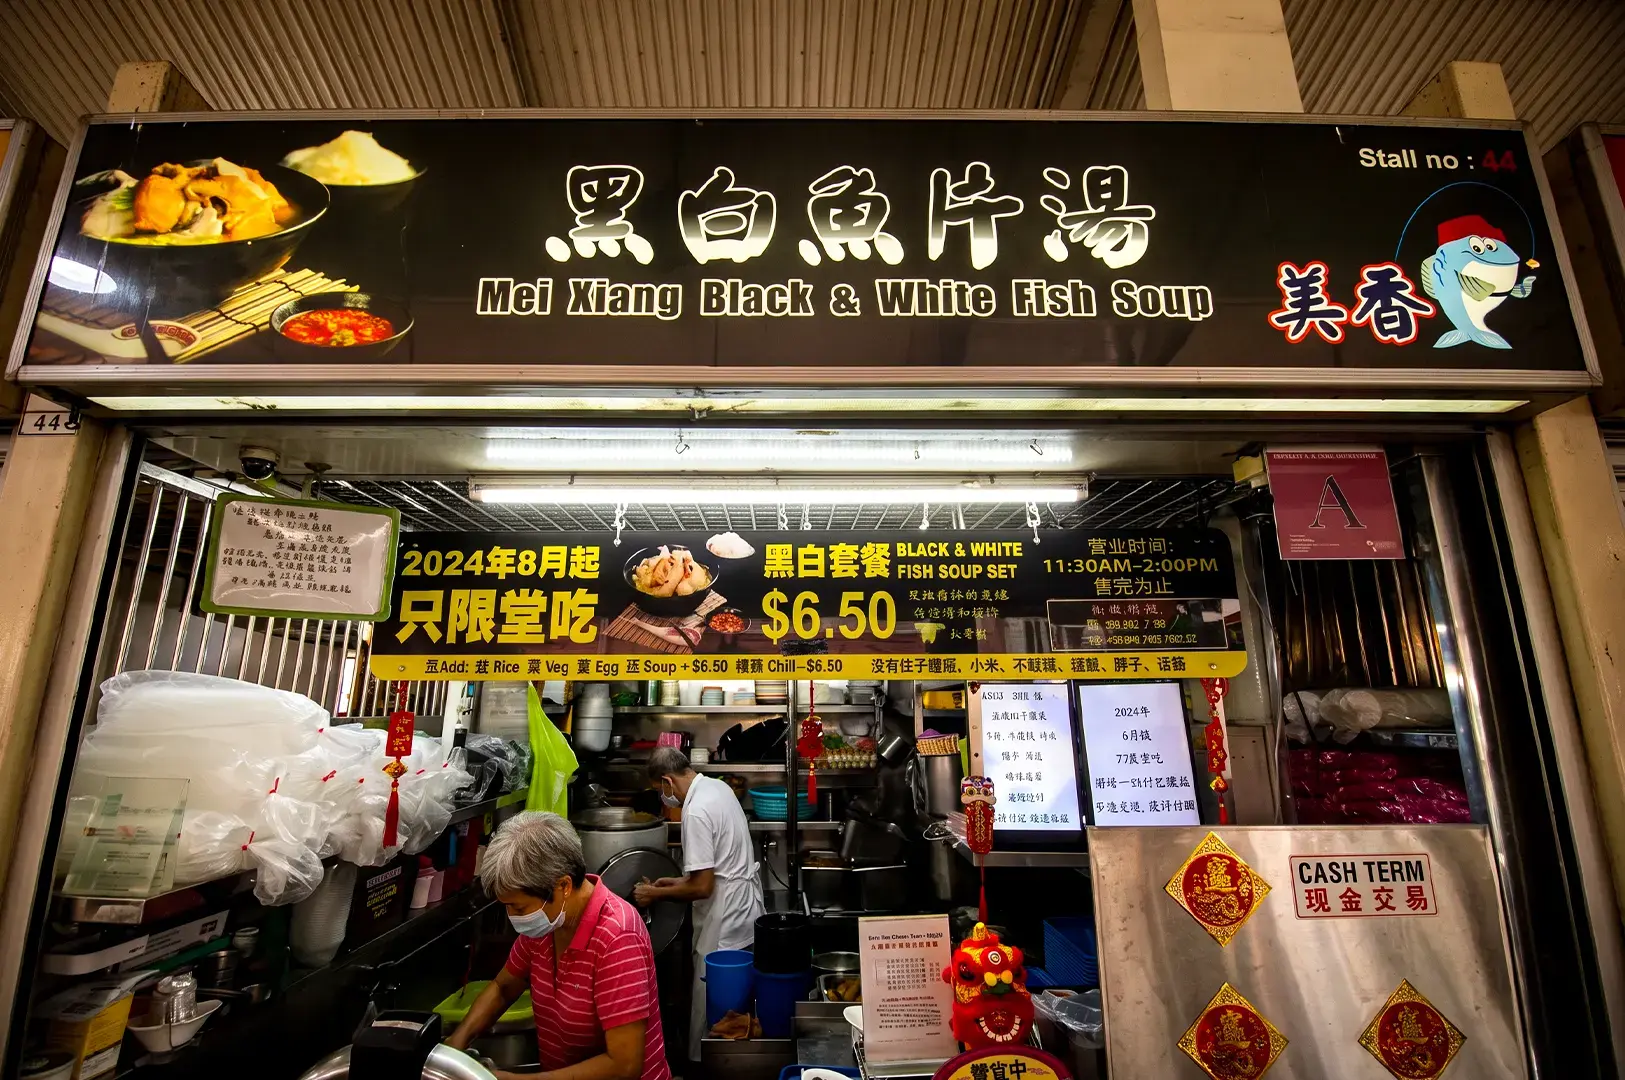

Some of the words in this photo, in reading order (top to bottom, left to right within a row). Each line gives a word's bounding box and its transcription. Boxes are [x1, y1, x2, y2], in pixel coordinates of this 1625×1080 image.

[1359, 148, 1418, 168] Stall
[1426, 154, 1459, 170] no
[1482, 150, 1517, 172] 44
[545, 162, 1156, 270] 黑白魚片湯
[477, 278, 552, 315] Mei
[567, 278, 683, 320] Xiang
[700, 279, 815, 317] Black
[830, 284, 861, 316] &
[875, 279, 997, 317] White
[1012, 279, 1097, 316] Fish
[1111, 280, 1213, 321] Soup
[1269, 262, 1436, 346] 美香
[1308, 474, 1368, 529] A
[401, 546, 600, 580] 2024年8月起
[763, 542, 891, 579] 黑白套餐
[897, 543, 950, 557] BLACK
[954, 543, 966, 557] &
[970, 542, 1023, 557] WHITE
[897, 565, 934, 579] FISH
[938, 564, 983, 579] SOUP
[987, 564, 1018, 579] SET
[1093, 577, 1175, 596] 售完为止
[395, 588, 599, 645] 只限堂吃
[761, 588, 896, 645] $6.50
[493, 660, 520, 674] Rice
[545, 660, 569, 676] Veg
[595, 660, 619, 676] Egg
[643, 659, 677, 676] Soup
[1114, 706, 1150, 718] 2024年
[1298, 862, 1358, 884] CASH
[1363, 860, 1425, 883] TERM
[1304, 885, 1428, 913] 现金交易
